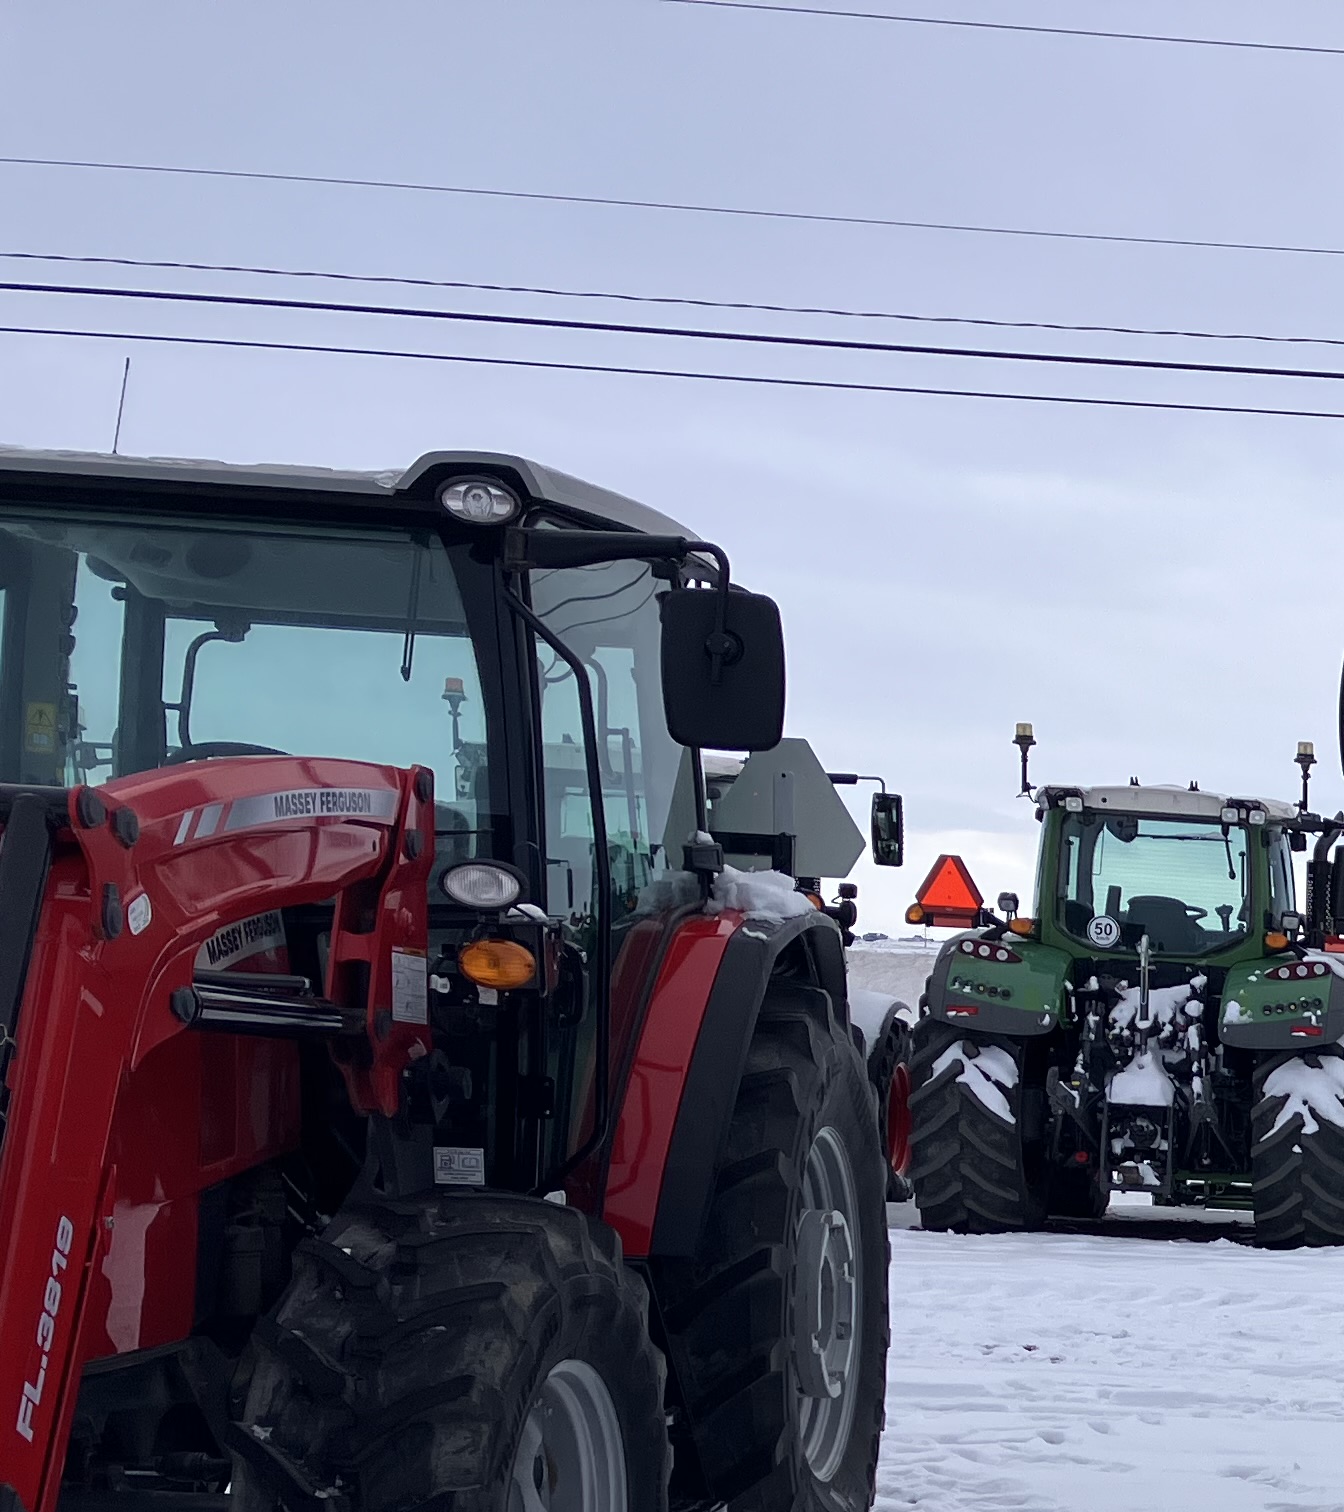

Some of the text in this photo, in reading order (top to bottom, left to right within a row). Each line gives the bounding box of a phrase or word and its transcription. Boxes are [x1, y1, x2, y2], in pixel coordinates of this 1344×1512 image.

[274, 791, 371, 818] MASSEY FERGUSON
[1094, 922, 1113, 936] 50
[206, 923, 243, 966] MASSEY
